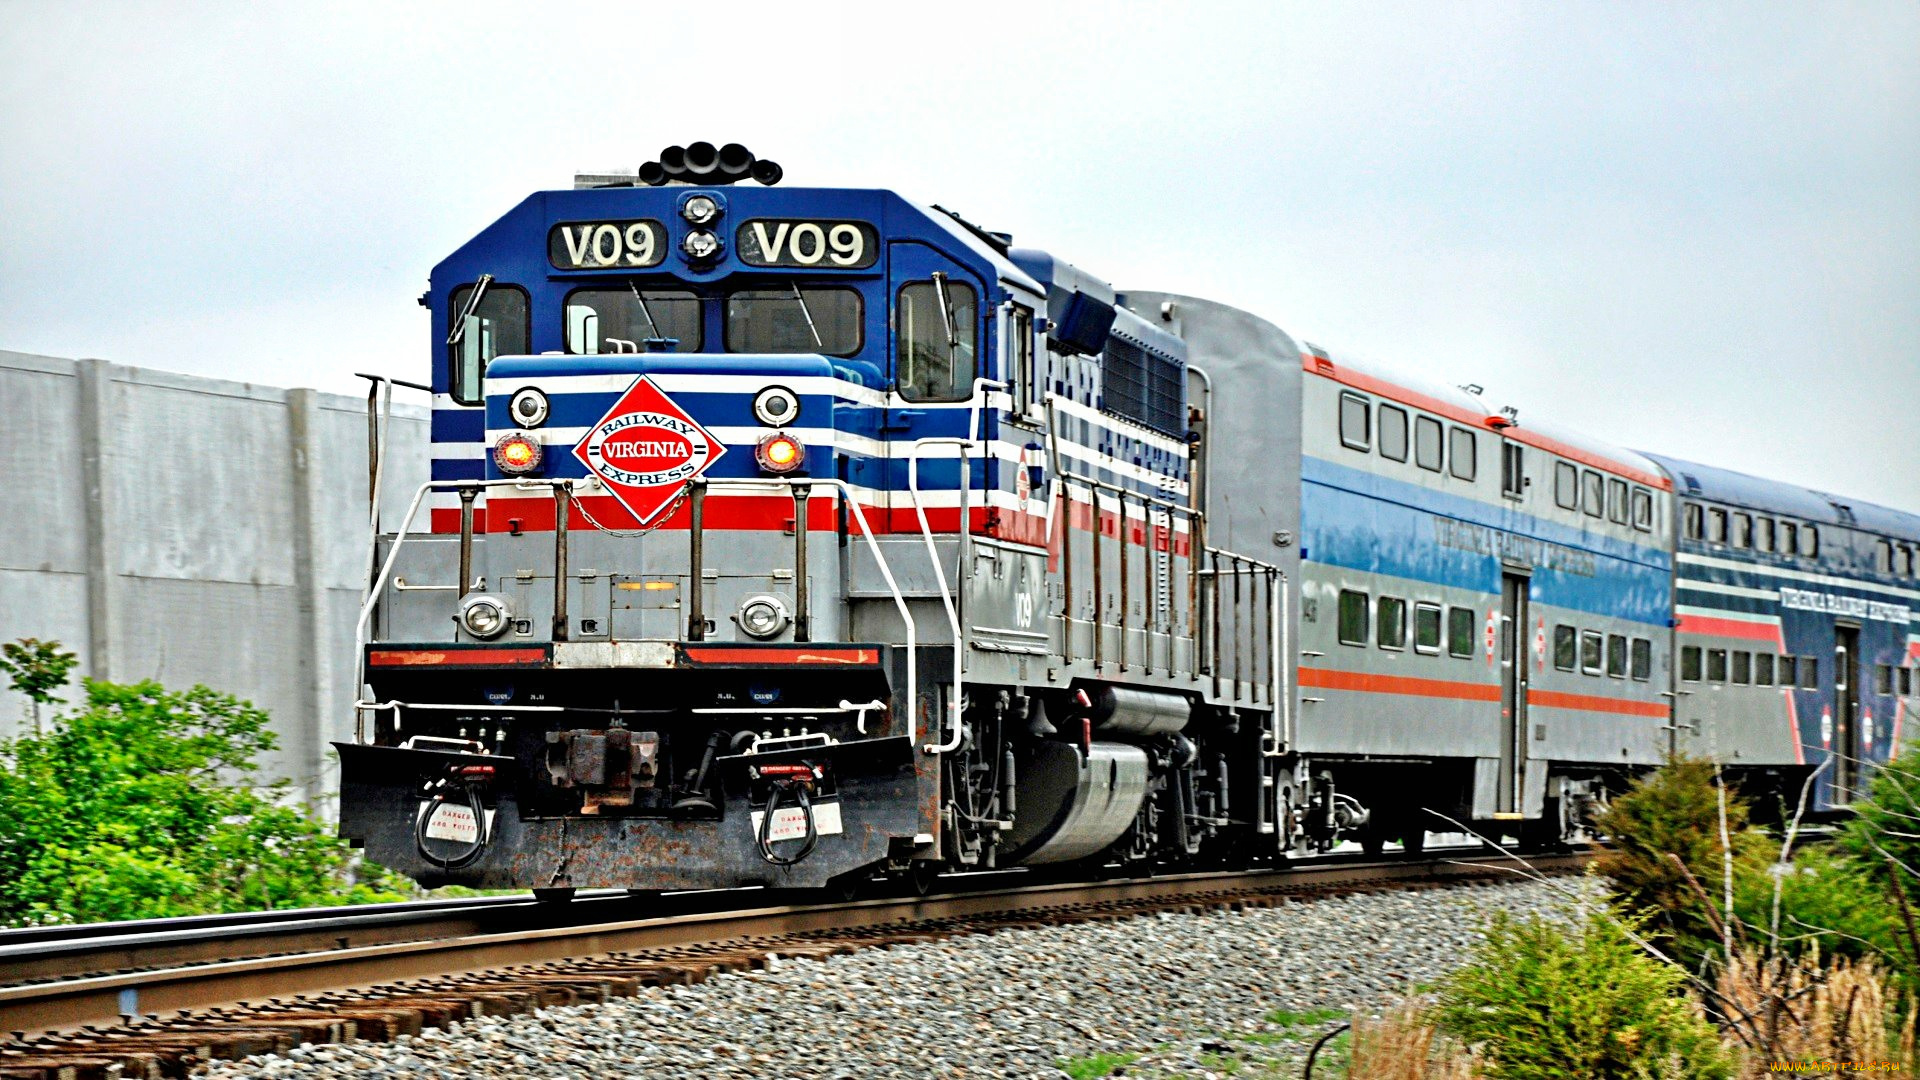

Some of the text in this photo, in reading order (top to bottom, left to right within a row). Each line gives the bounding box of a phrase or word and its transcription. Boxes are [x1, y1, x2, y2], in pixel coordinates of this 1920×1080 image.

[561, 223, 655, 266] V09
[752, 222, 864, 265] V09
[601, 414, 696, 436] RAILWAY
[603, 441, 689, 458] VIRGINIA
[599, 463, 695, 485] EXPRESS
[442, 810, 471, 820] DANGER
